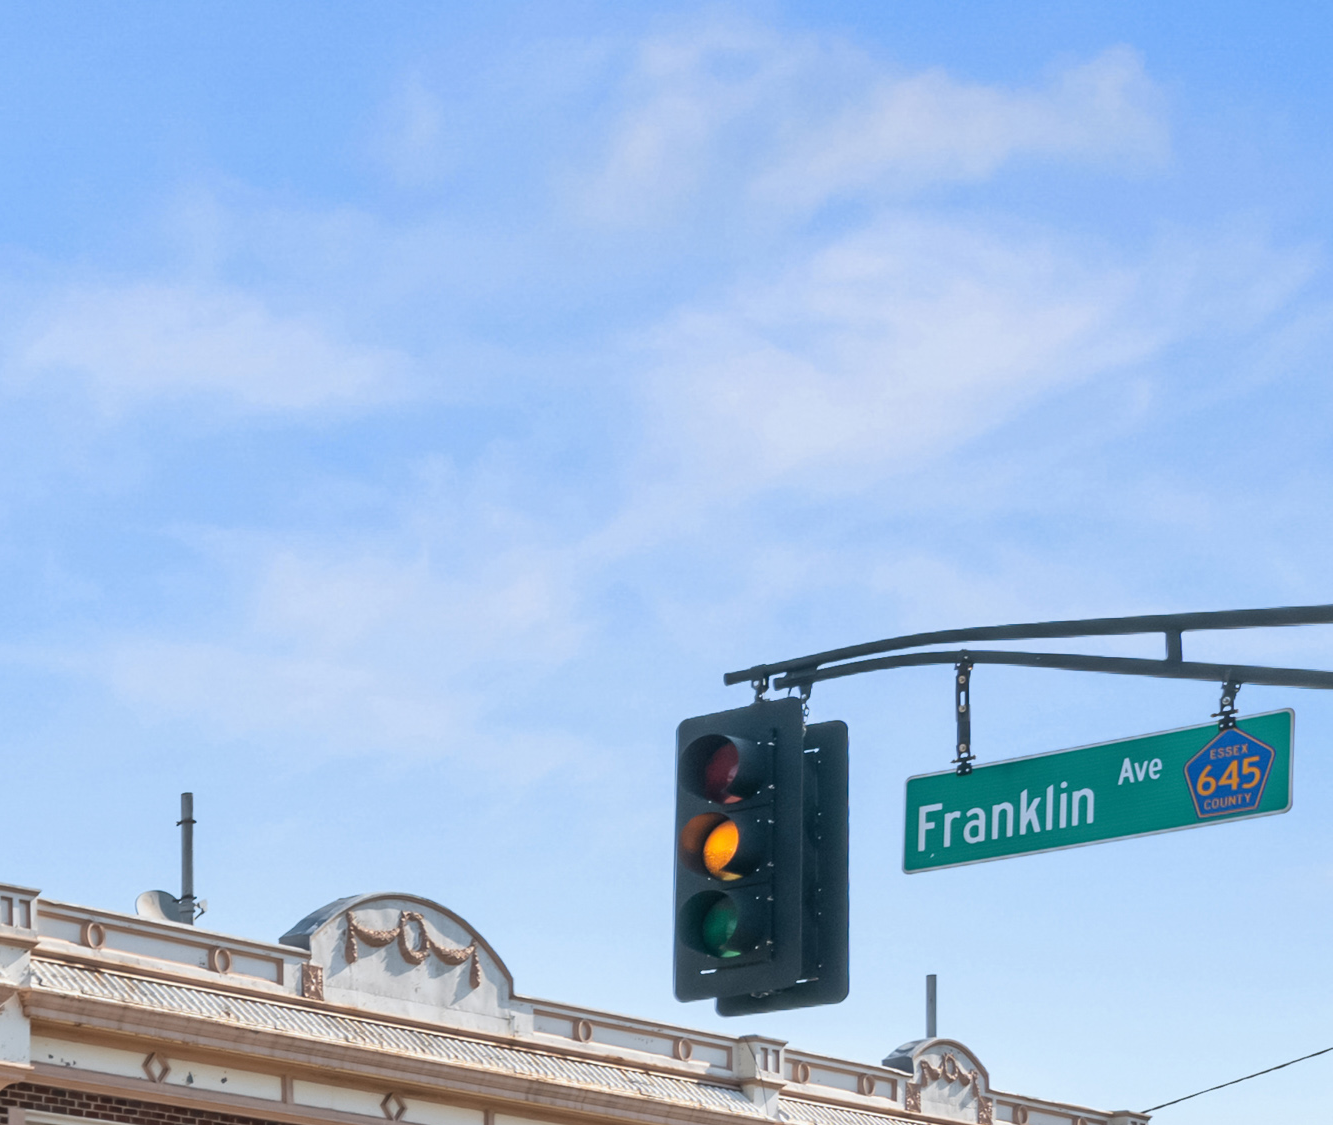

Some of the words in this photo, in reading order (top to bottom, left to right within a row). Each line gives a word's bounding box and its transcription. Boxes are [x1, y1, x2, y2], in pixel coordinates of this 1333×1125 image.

[1209, 744, 1249, 761] ESSEX
[1196, 755, 1262, 797] 645
[917, 781, 1095, 853] Franklin
[1117, 757, 1163, 786] Ave
[1203, 793, 1252, 811] COUNTY
